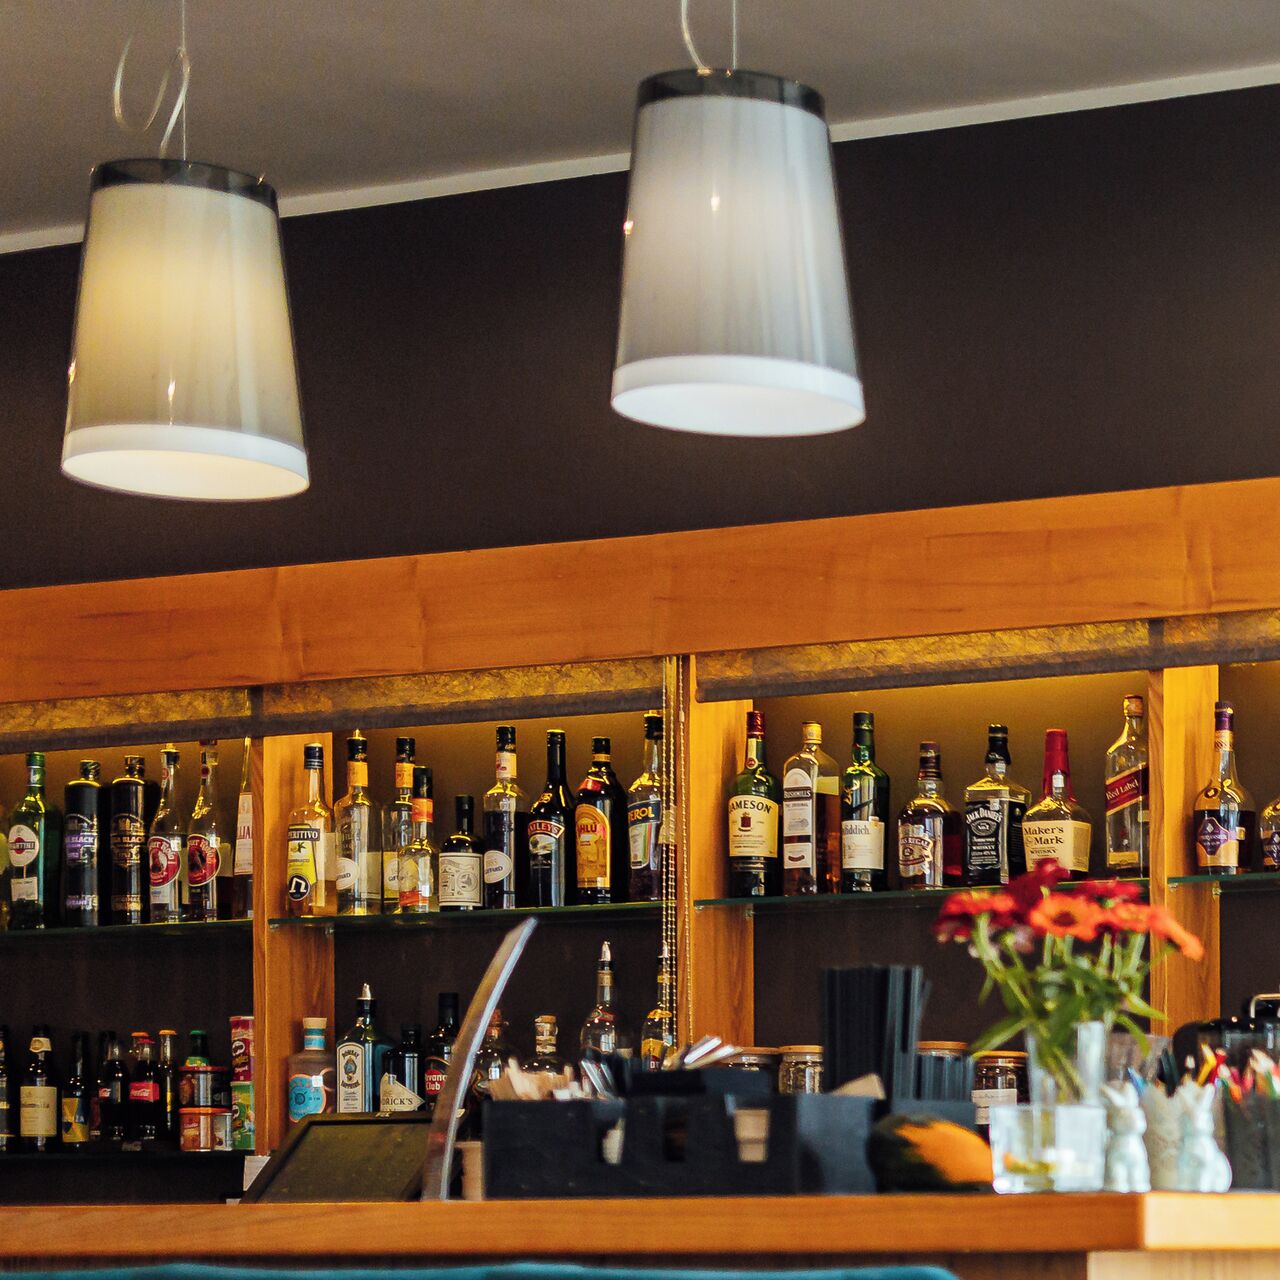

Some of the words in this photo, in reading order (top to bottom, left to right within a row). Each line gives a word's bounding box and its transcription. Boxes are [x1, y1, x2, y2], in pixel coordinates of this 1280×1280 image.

[1106, 788, 1120, 800] Red
[1119, 780, 1138, 793] Label
[728, 800, 772, 815] JAMESON
[1023, 826, 1064, 836] Maker's
[1033, 836, 1064, 845] Mark
